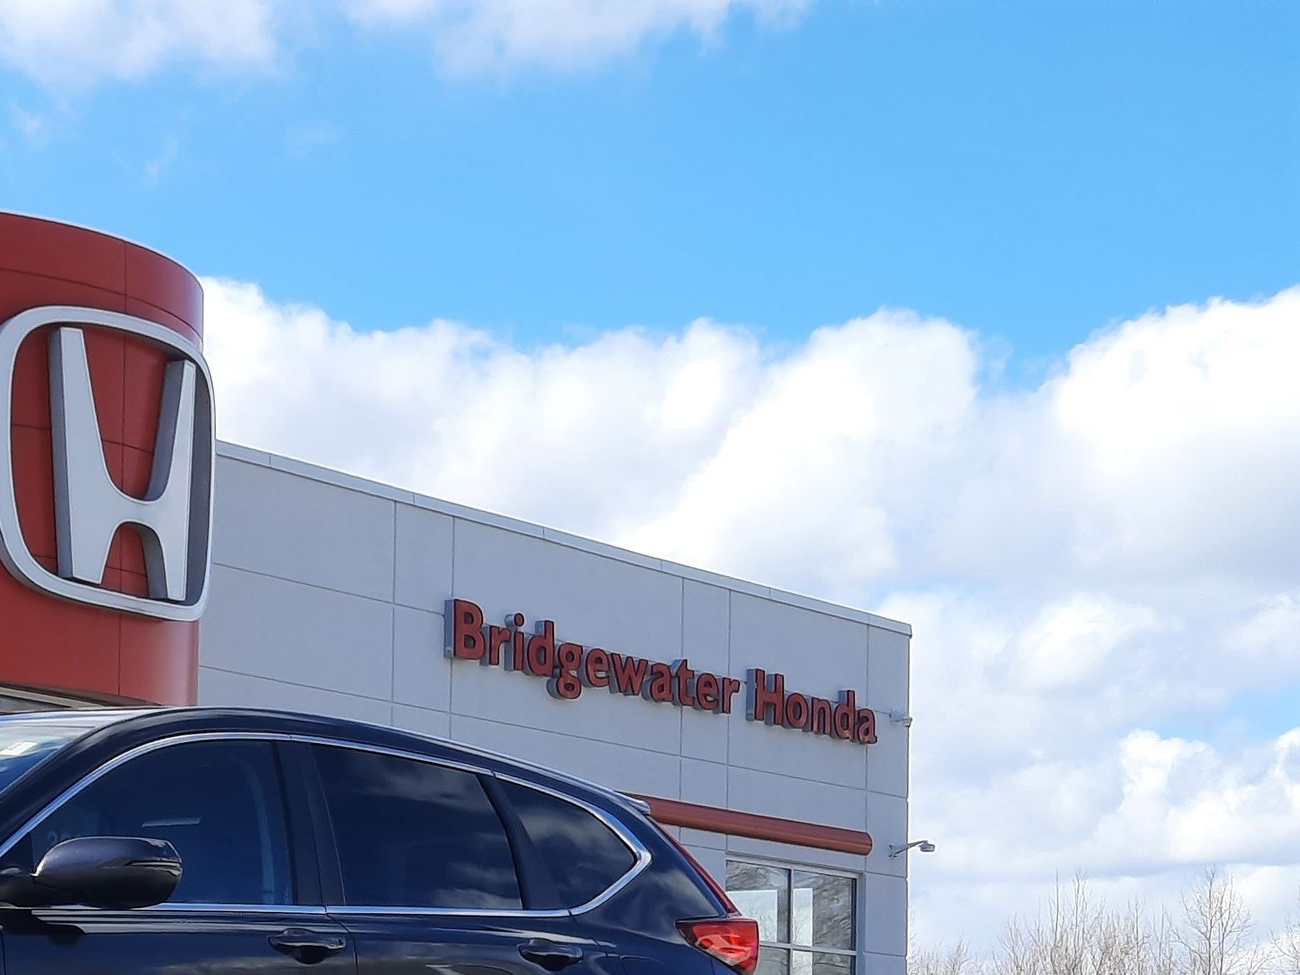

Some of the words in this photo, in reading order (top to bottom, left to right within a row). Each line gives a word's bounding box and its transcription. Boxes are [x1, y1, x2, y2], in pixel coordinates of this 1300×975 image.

[48, 326, 197, 602] H
[451, 598, 740, 714] Bridgewater
[752, 668, 878, 745] Honda
